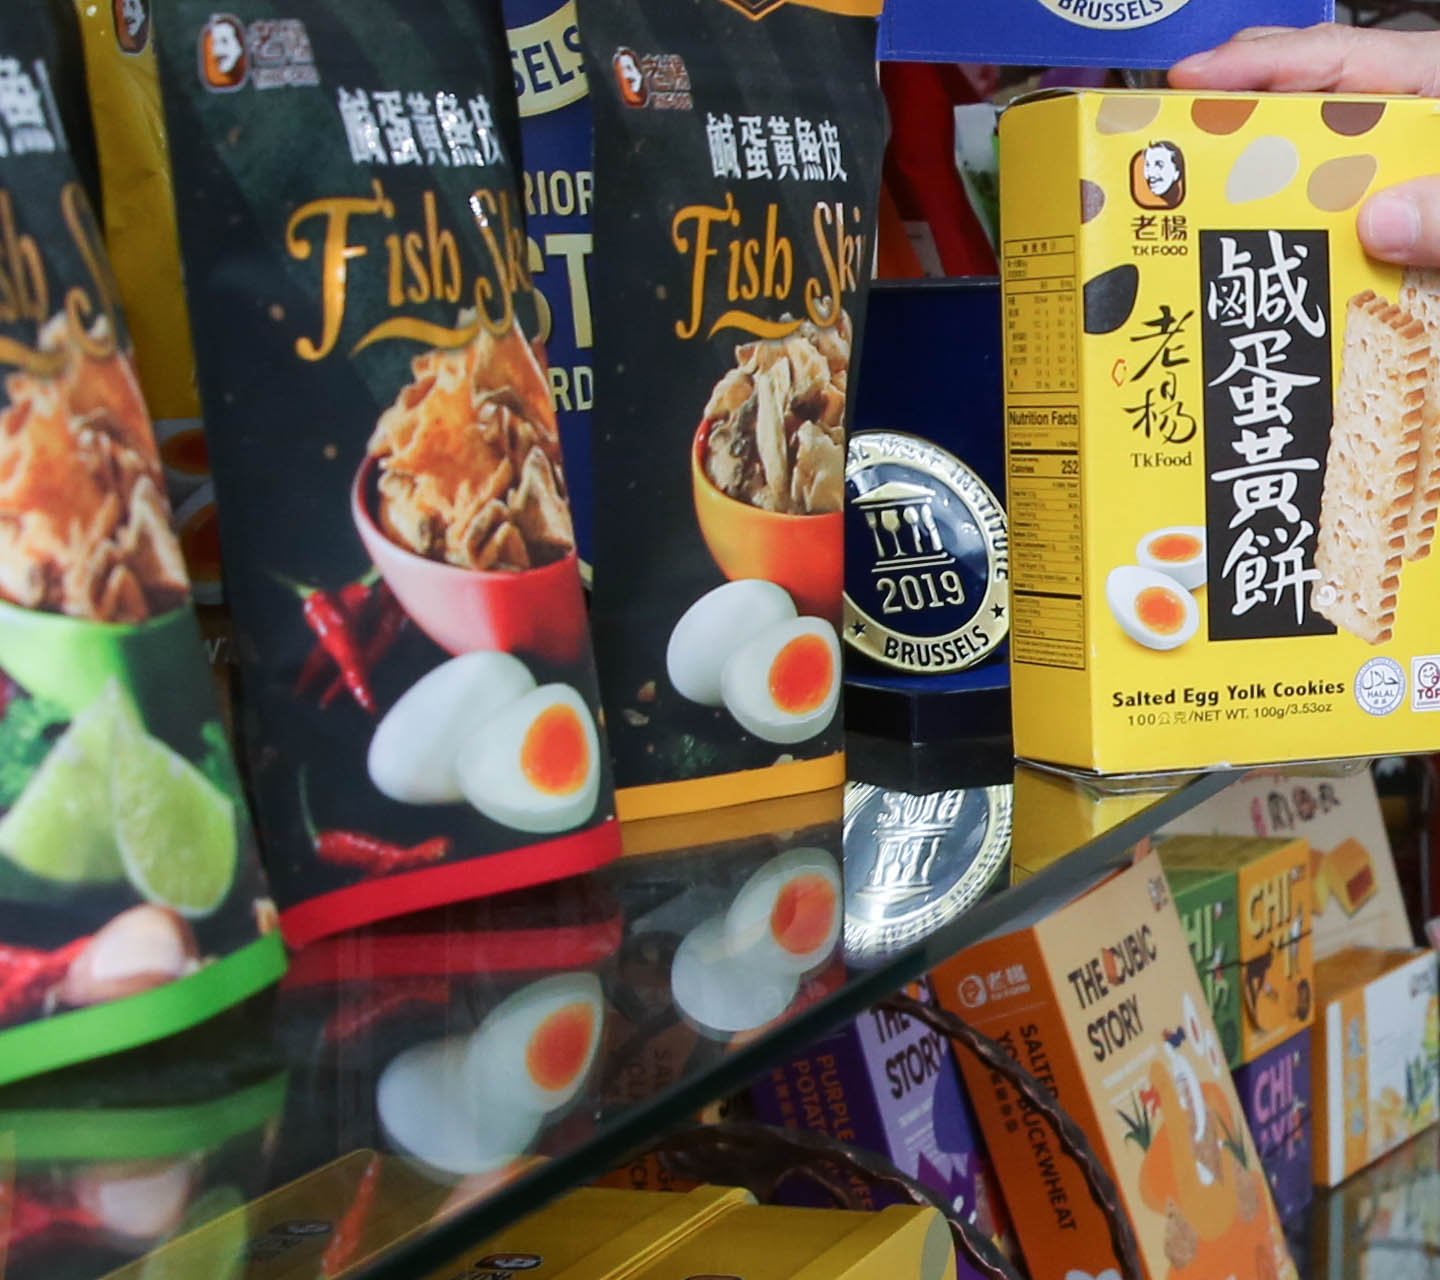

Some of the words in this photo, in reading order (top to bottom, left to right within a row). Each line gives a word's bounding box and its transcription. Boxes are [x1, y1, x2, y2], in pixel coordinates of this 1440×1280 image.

[705, 111, 848, 182] 鹹蛋黃魚皮
[1132, 215, 1189, 241] 老楊
[1154, 245, 1189, 257] FOOD
[286, 185, 460, 363] Fish
[672, 194, 793, 341] Fish
[1009, 410, 1050, 426] Nutrition
[1051, 410, 1079, 426] Facts
[1207, 229, 1329, 626] 鹹蛋黃餅
[1061, 459, 1079, 475] 252
[876, 570, 966, 615] 2019
[884, 624, 990, 667] BRUSSELS
[1112, 688, 1176, 709] Salted
[1183, 688, 1219, 707] Egg
[1227, 683, 1266, 701] Yolk
[1273, 679, 1346, 699] Cookies
[1366, 687, 1396, 699] HALAL
[1067, 957, 1109, 1010] THE
[1103, 923, 1157, 987] CUBIC
[1087, 993, 1144, 1063] STORY
[885, 1030, 944, 1101] STORY
[817, 1054, 856, 1143] PURPLE
